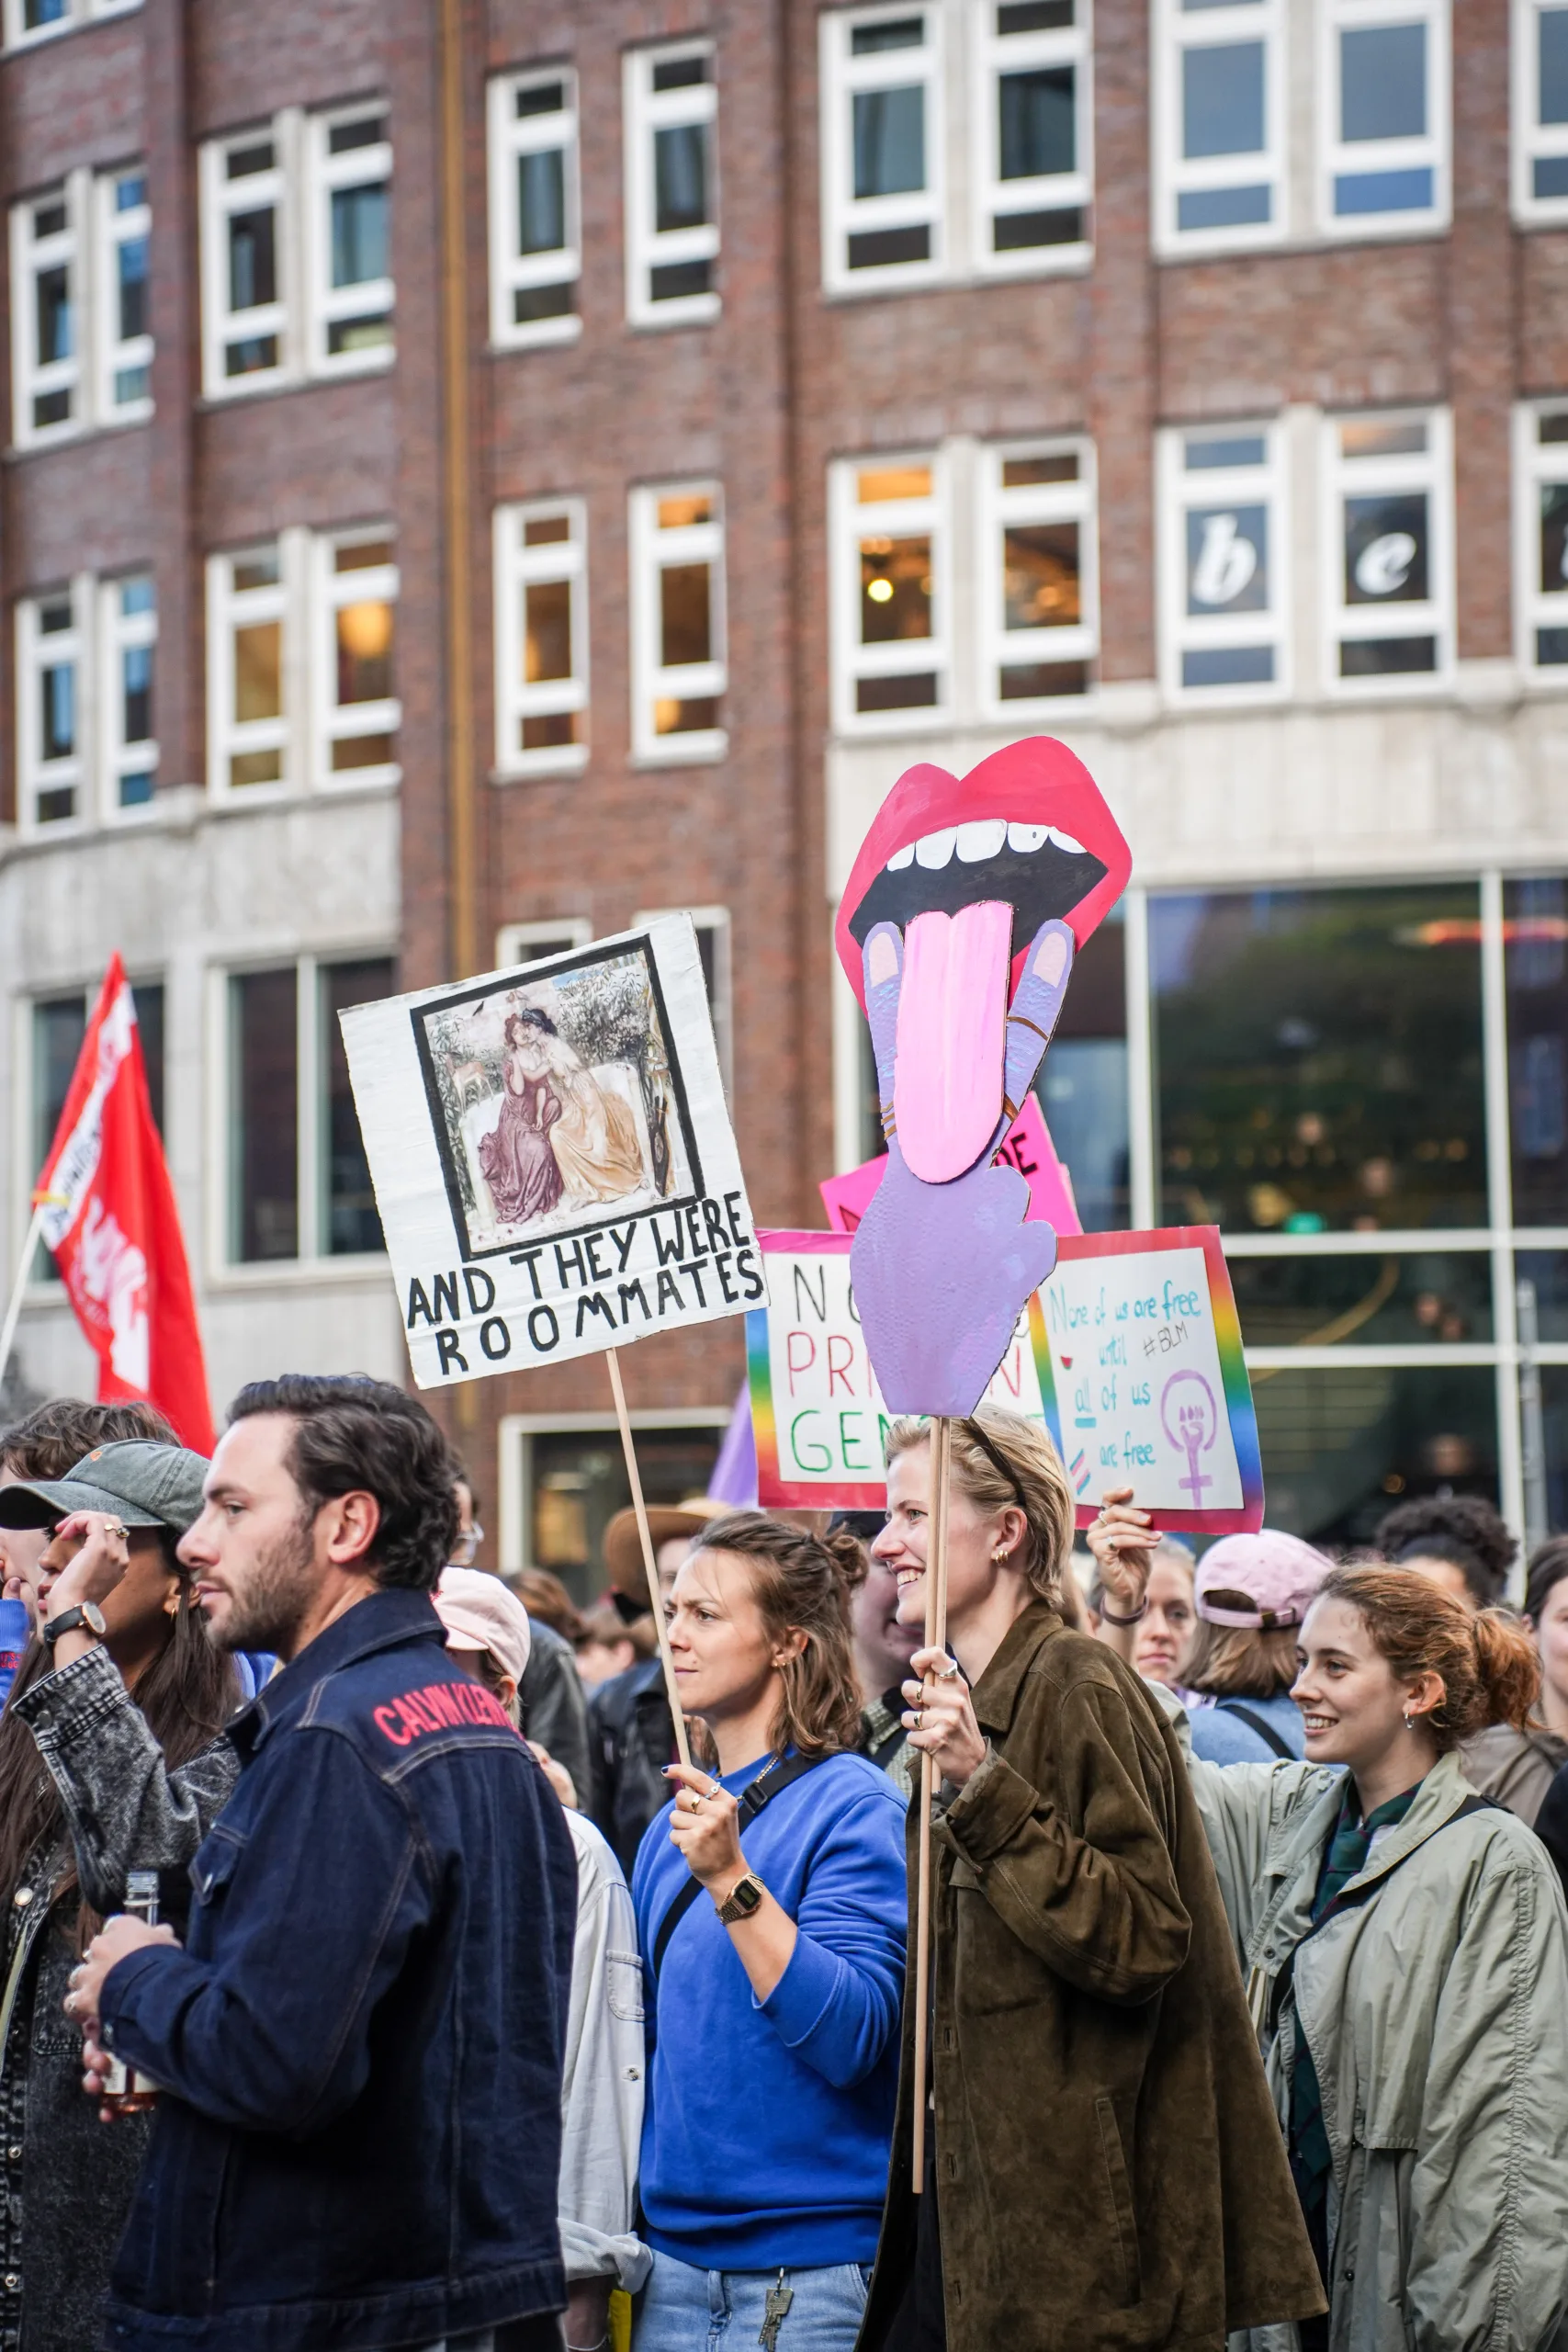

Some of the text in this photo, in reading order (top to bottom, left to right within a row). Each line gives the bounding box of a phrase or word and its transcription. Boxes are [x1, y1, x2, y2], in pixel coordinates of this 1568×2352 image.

[407, 1191, 752, 1329] AND THEY WERE
[435, 1249, 764, 1376] ROOMMATES
[1049, 1279, 1201, 1333] None of us are free
[1099, 1320, 1189, 1367] until #BLM
[1075, 1373, 1151, 1413] all of us
[1100, 1430, 1156, 1469] are free
